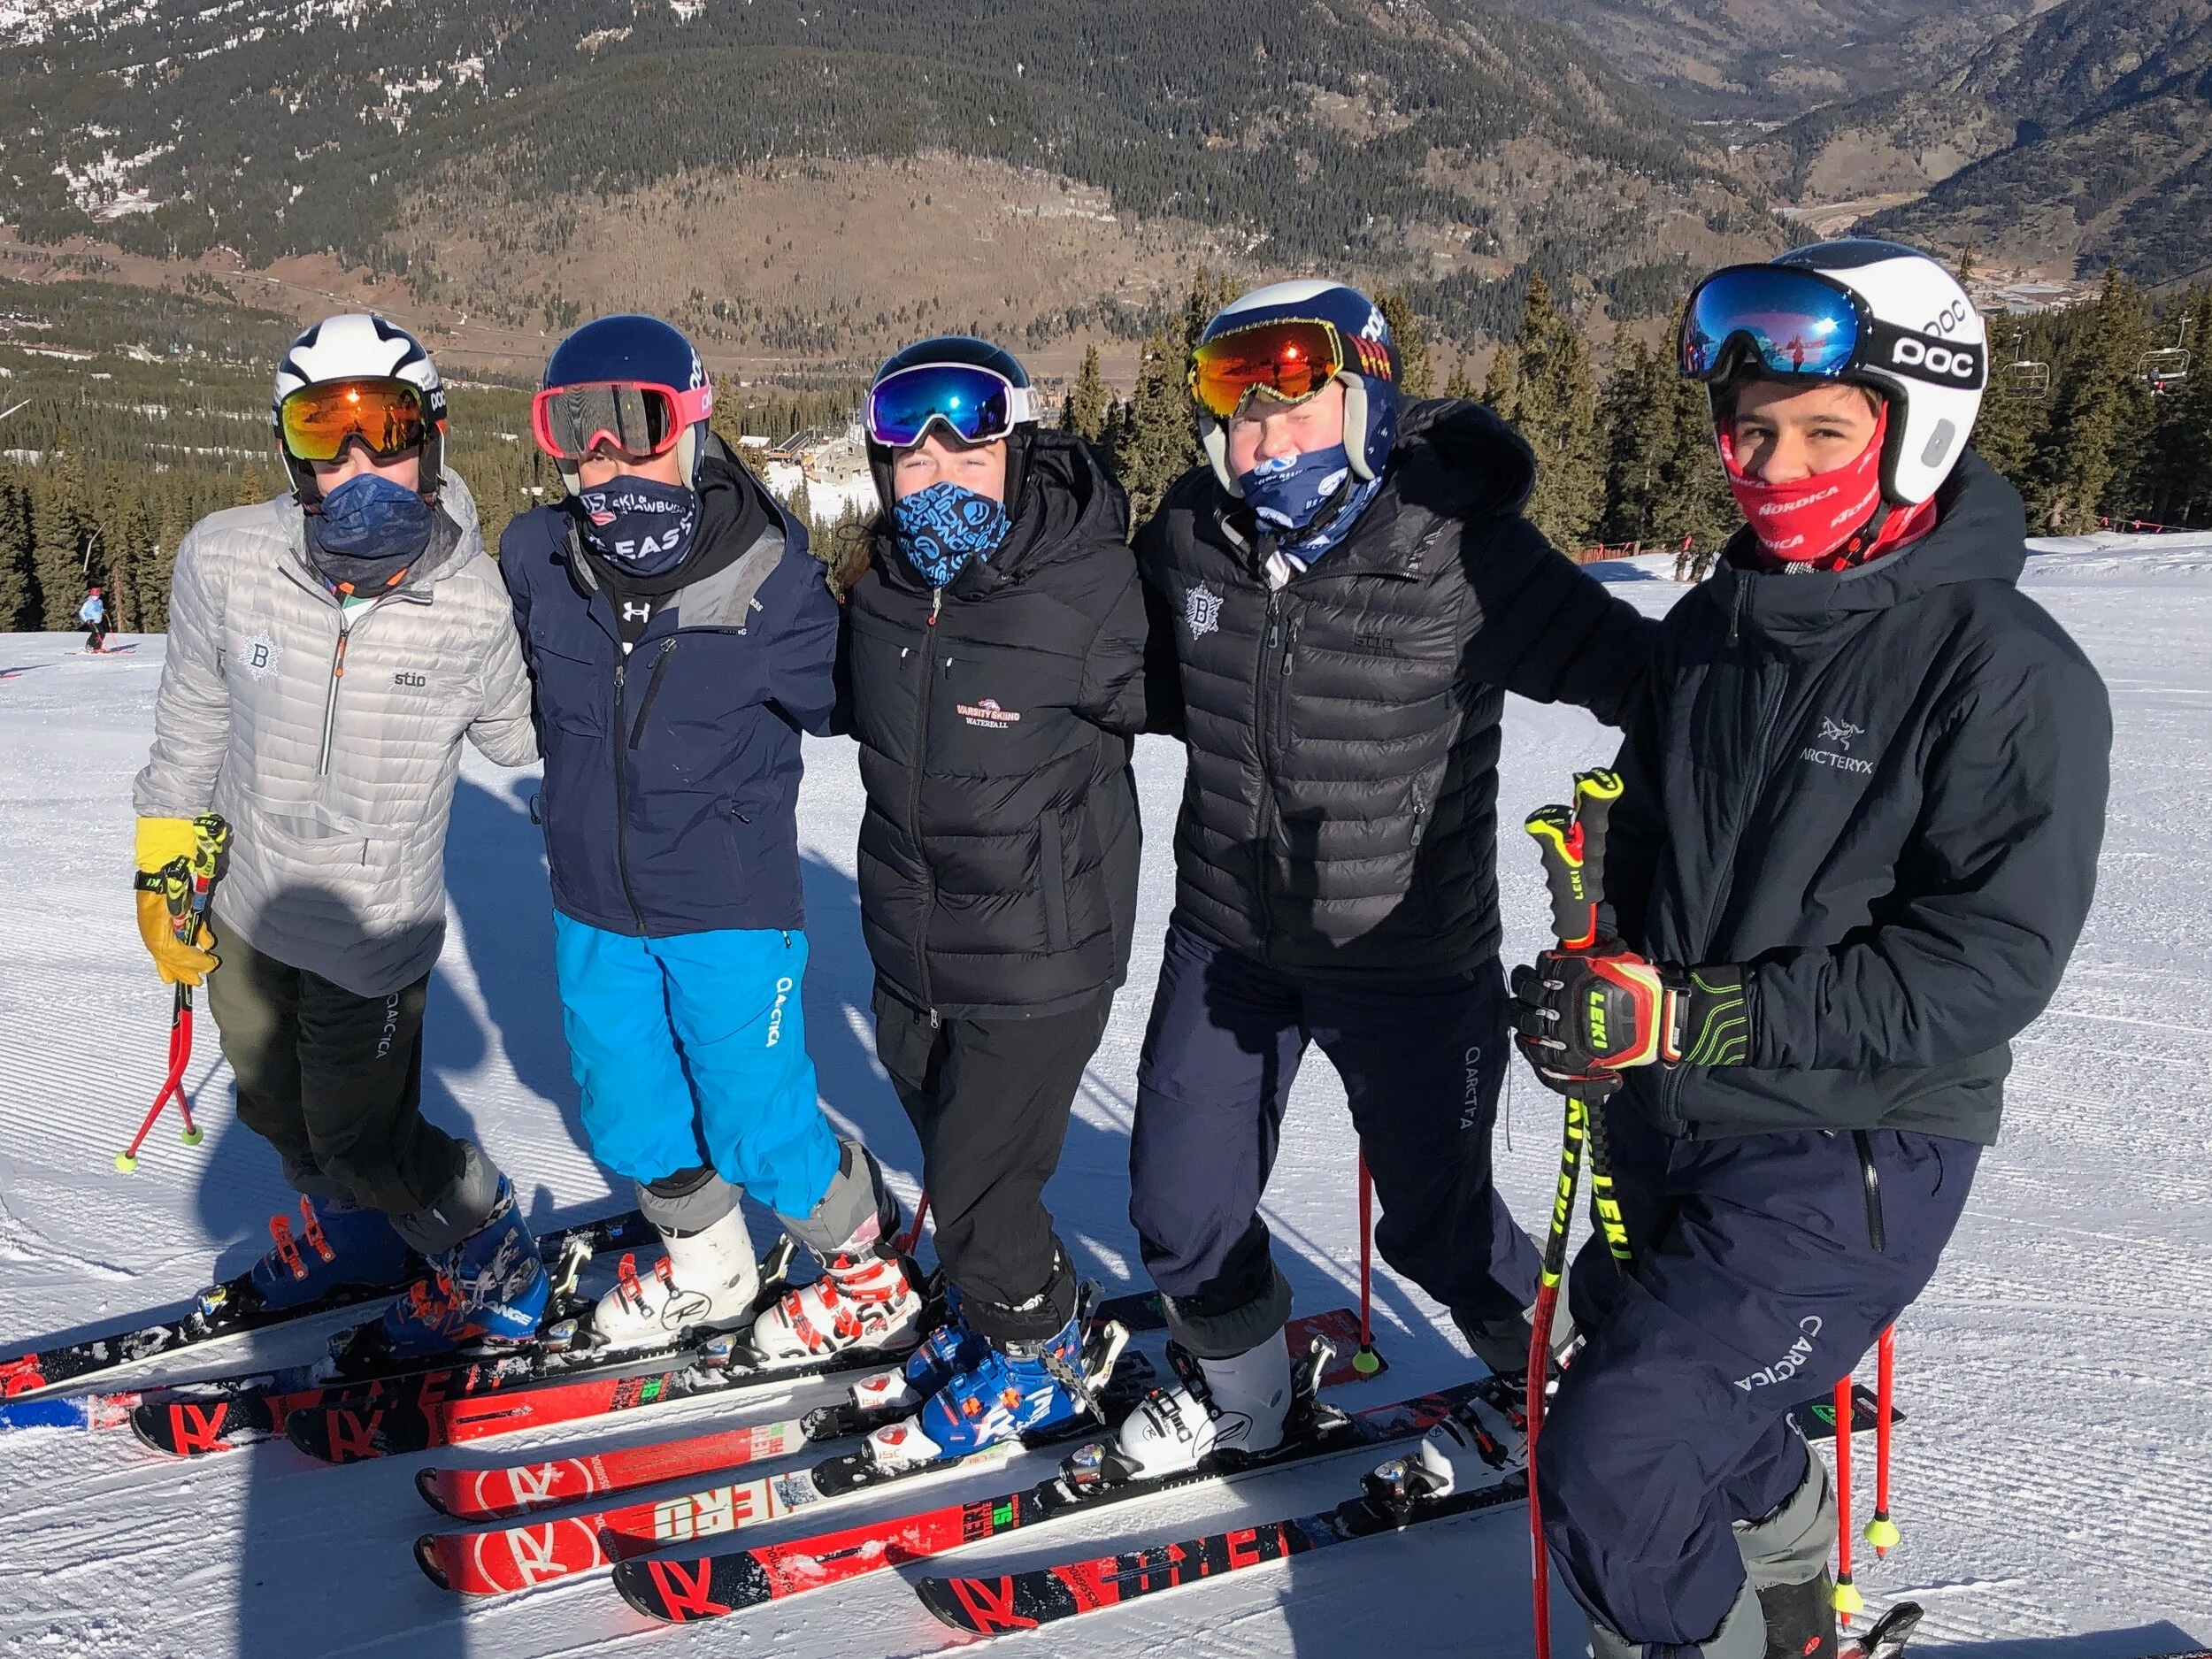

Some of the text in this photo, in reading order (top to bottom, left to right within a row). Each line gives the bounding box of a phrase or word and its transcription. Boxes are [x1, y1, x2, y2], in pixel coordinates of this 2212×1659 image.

[1759, 486, 1839, 516] NORDICA
[956, 704, 992, 718] VARSITY
[966, 718, 1009, 729] WATERFALL
[1570, 871, 1584, 900] LEKI
[1591, 990, 1609, 1049] LEKI
[1593, 1174, 1632, 1259] LEKI
